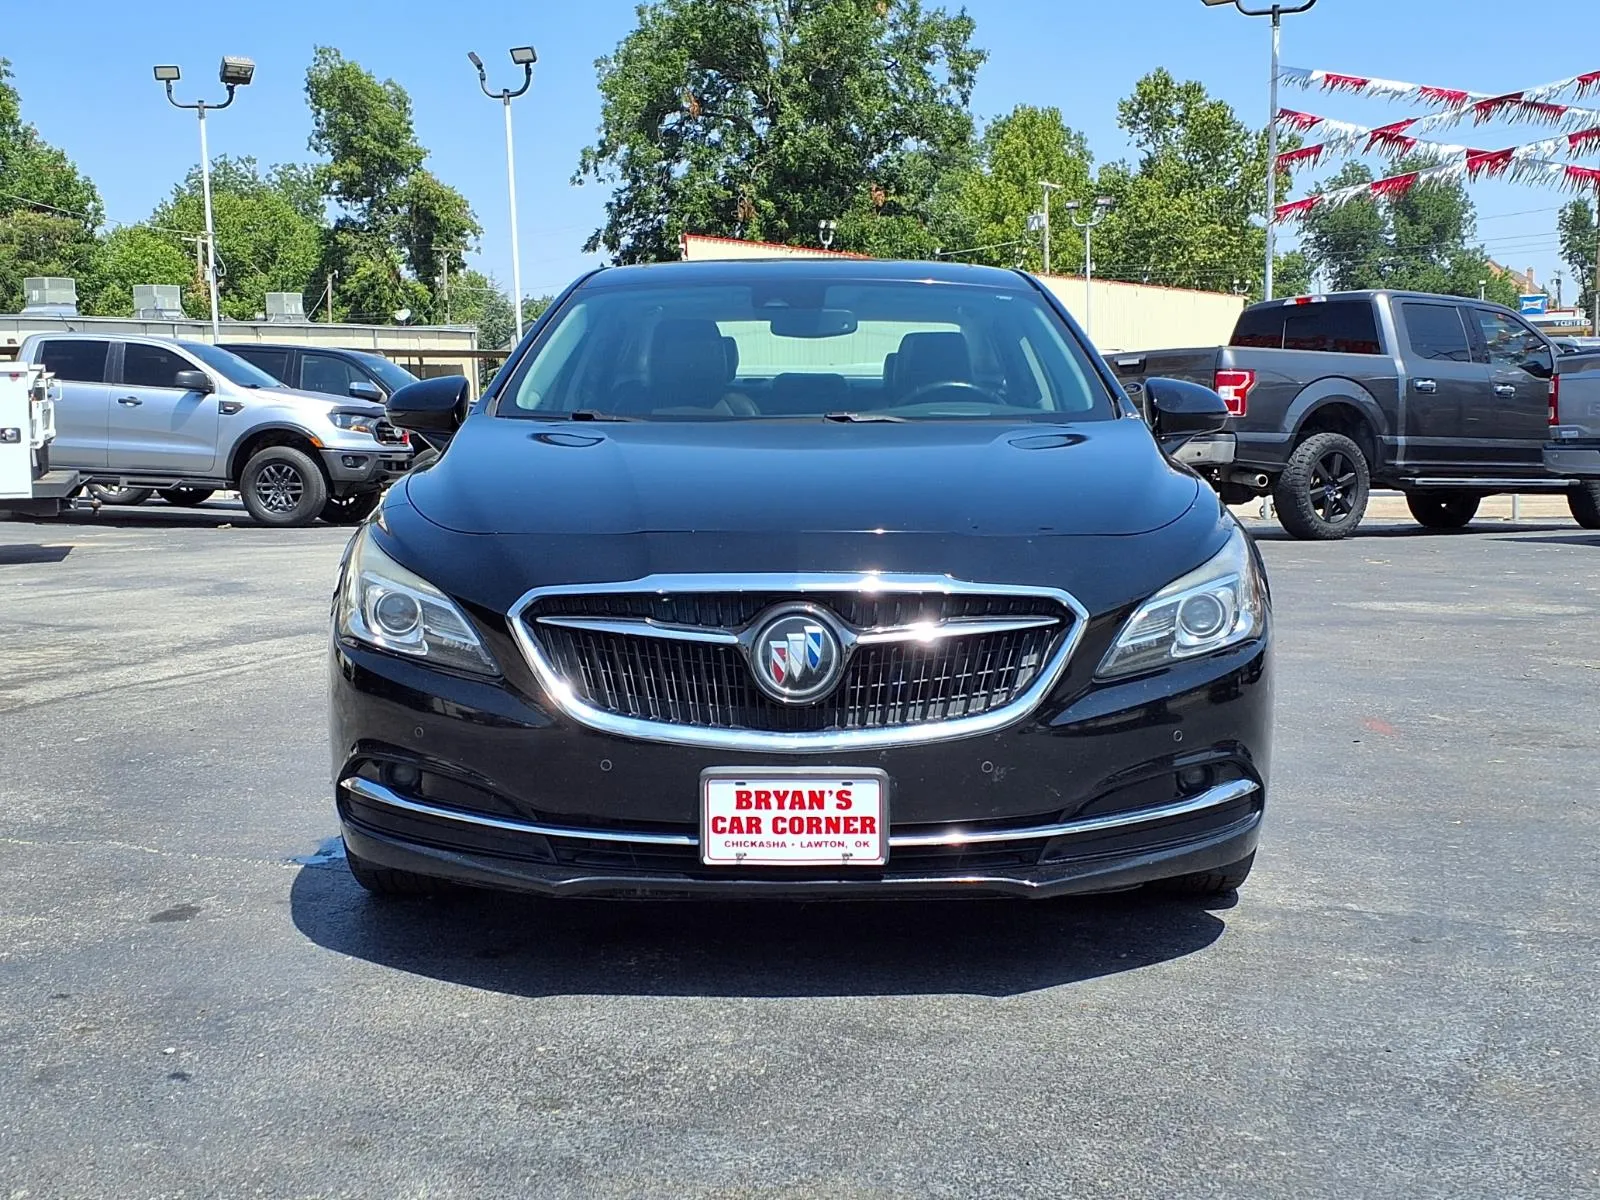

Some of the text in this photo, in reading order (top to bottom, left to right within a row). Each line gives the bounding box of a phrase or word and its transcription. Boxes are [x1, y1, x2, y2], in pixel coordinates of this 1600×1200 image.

[735, 790, 853, 811] BRYAN'S
[711, 816, 877, 835] CAR CORNER
[724, 840, 870, 849] CHICKASHA LAWTON, OK
